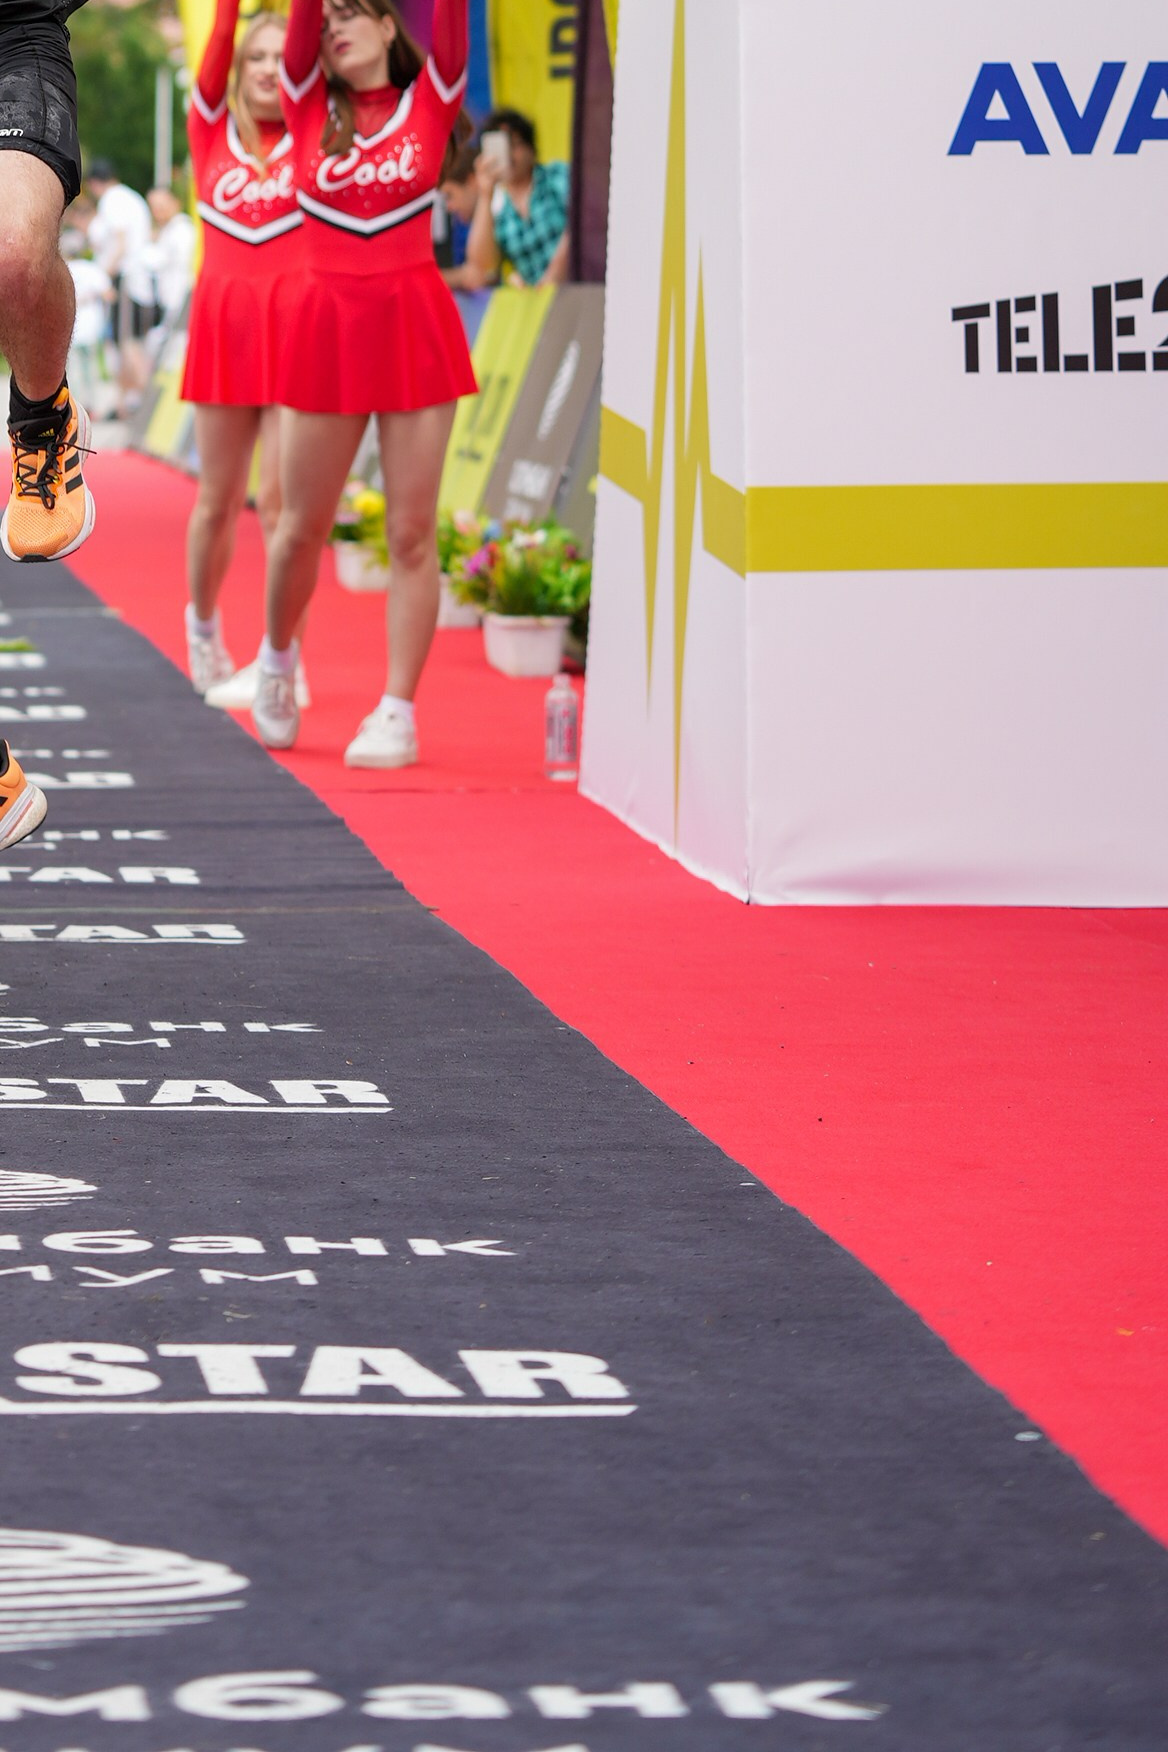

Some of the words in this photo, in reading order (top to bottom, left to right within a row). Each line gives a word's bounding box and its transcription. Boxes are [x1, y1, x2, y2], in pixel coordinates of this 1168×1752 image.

[946, 60, 1168, 157] AVA
[212, 164, 295, 212] Cool
[316, 143, 417, 193] Cool
[14, 1341, 631, 1400] STAR
